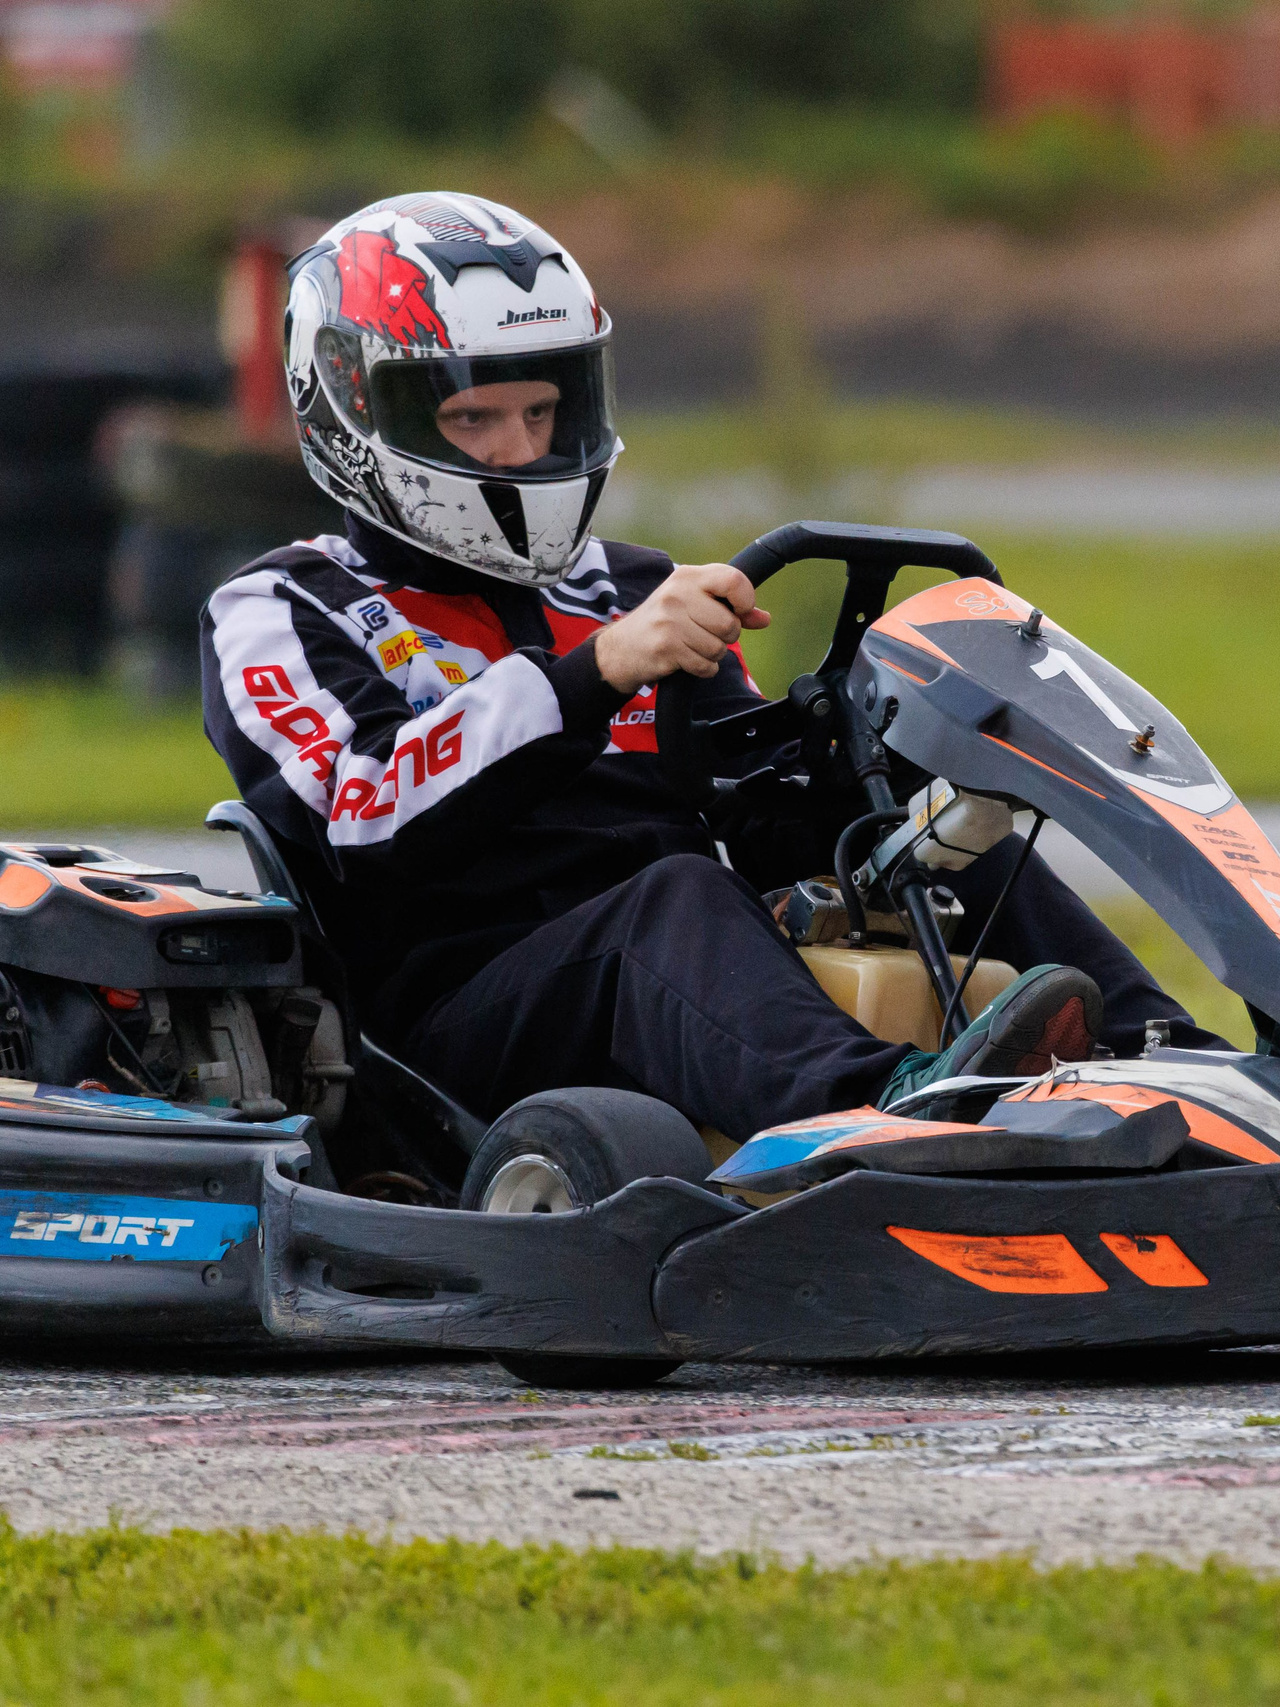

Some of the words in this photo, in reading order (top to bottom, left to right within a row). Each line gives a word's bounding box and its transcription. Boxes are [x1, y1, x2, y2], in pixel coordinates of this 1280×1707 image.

[1029, 647, 1141, 733] 1
[1146, 773, 1191, 784] SPORT
[10, 1211, 195, 1247] SPORT
